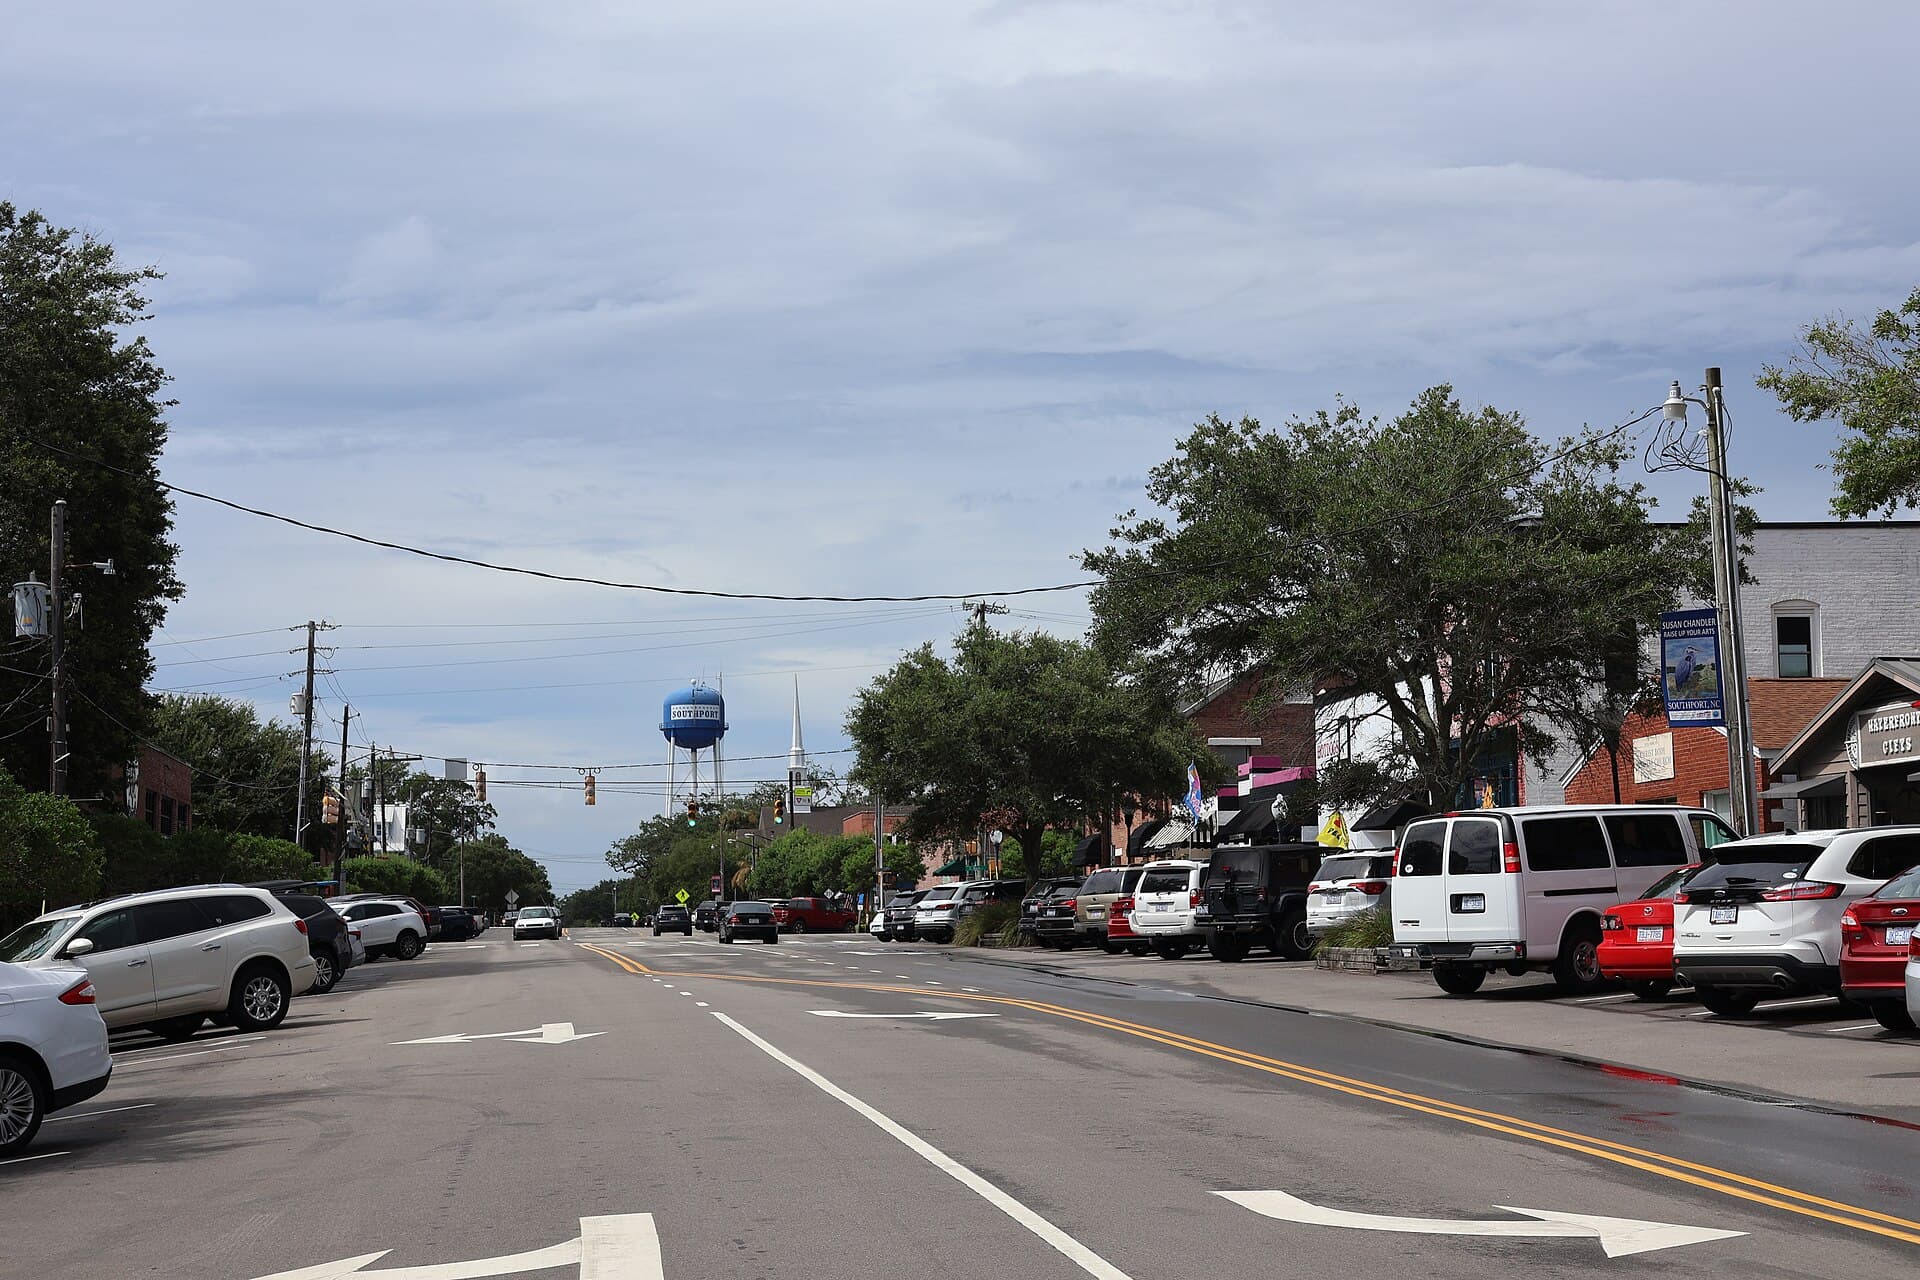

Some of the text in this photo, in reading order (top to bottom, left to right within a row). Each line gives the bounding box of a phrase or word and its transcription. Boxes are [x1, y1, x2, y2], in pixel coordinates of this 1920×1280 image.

[1662, 618, 1717, 630] SUSAN CHANDLER
[1711, 700, 1721, 708] NC
[672, 711, 719, 719] SOUTHPORT
[1882, 736, 1912, 755] GIFTS
